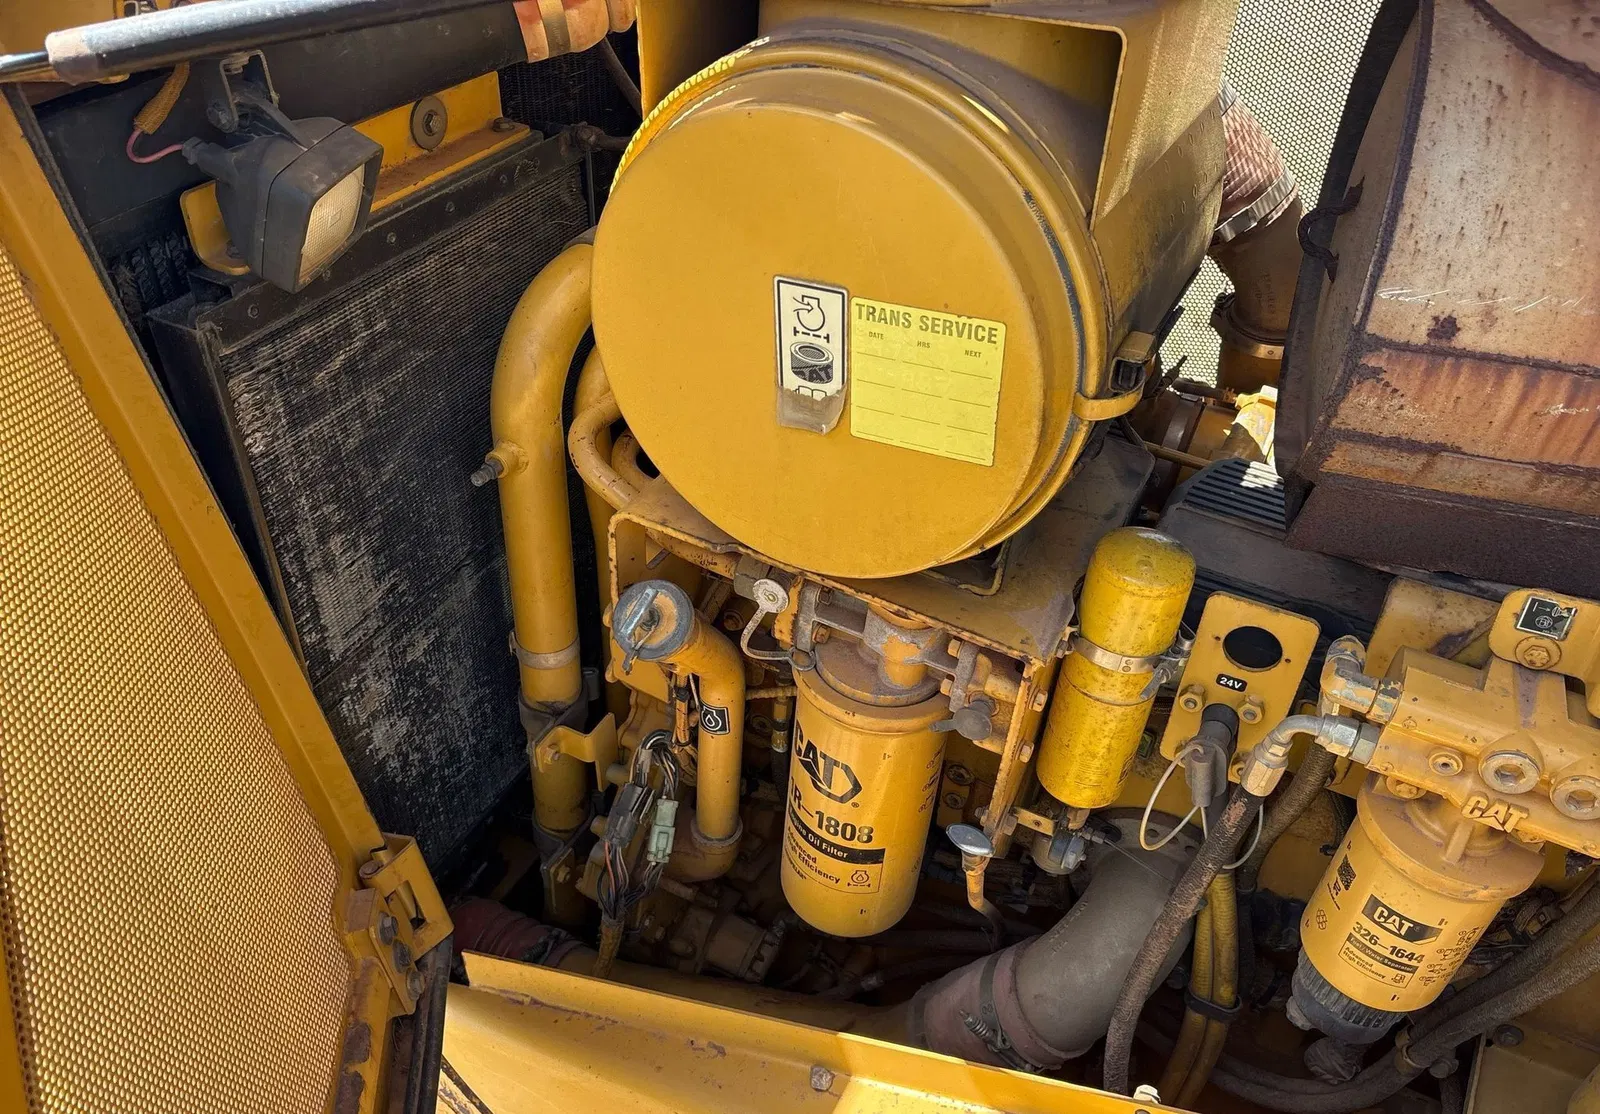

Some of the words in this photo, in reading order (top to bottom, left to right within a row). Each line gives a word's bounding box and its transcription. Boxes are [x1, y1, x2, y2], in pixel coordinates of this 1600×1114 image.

[855, 303, 912, 329] TRANS
[919, 315, 998, 345] SERVICE
[868, 331, 884, 341] DATE
[917, 340, 931, 349] HRS
[964, 349, 982, 359] NEXT
[1219, 676, 1243, 689] 24V
[795, 719, 841, 790] CAT
[1461, 795, 1529, 834] CAT
[808, 833, 820, 847] Oil
[822, 843, 849, 858] Filter
[798, 853, 840, 884] Efficiency
[1373, 906, 1414, 937] CAT
[1352, 921, 1425, 964] 326-1644
[1344, 946, 1374, 968] Advanced
[1383, 956, 1414, 973] Separator
